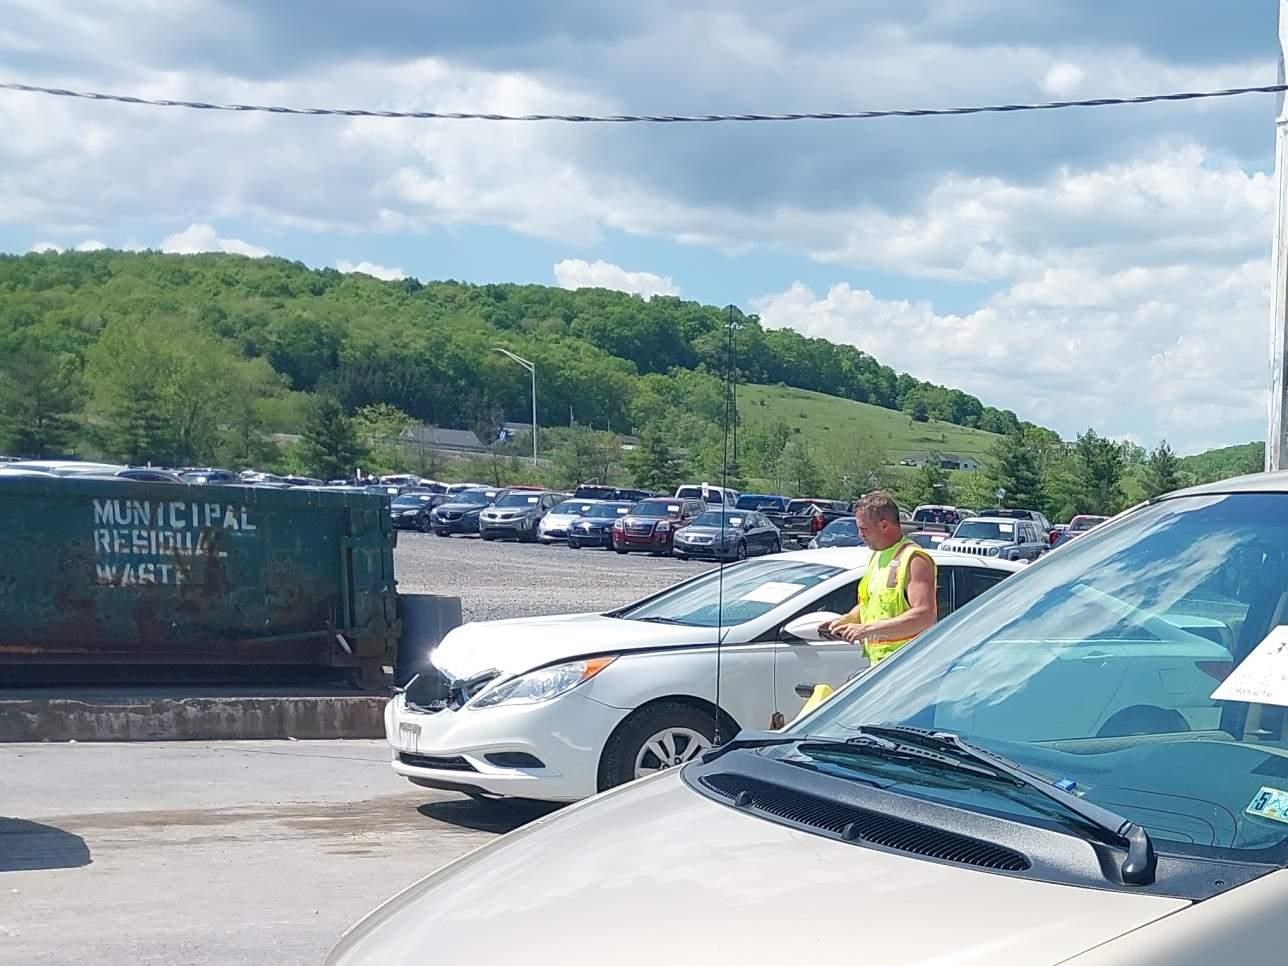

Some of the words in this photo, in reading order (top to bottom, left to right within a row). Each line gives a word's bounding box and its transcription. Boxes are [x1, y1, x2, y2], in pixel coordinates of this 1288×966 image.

[93, 499, 257, 530] MUNICIPAL
[96, 562, 193, 587] WASTE
[1255, 792, 1271, 811] 5
